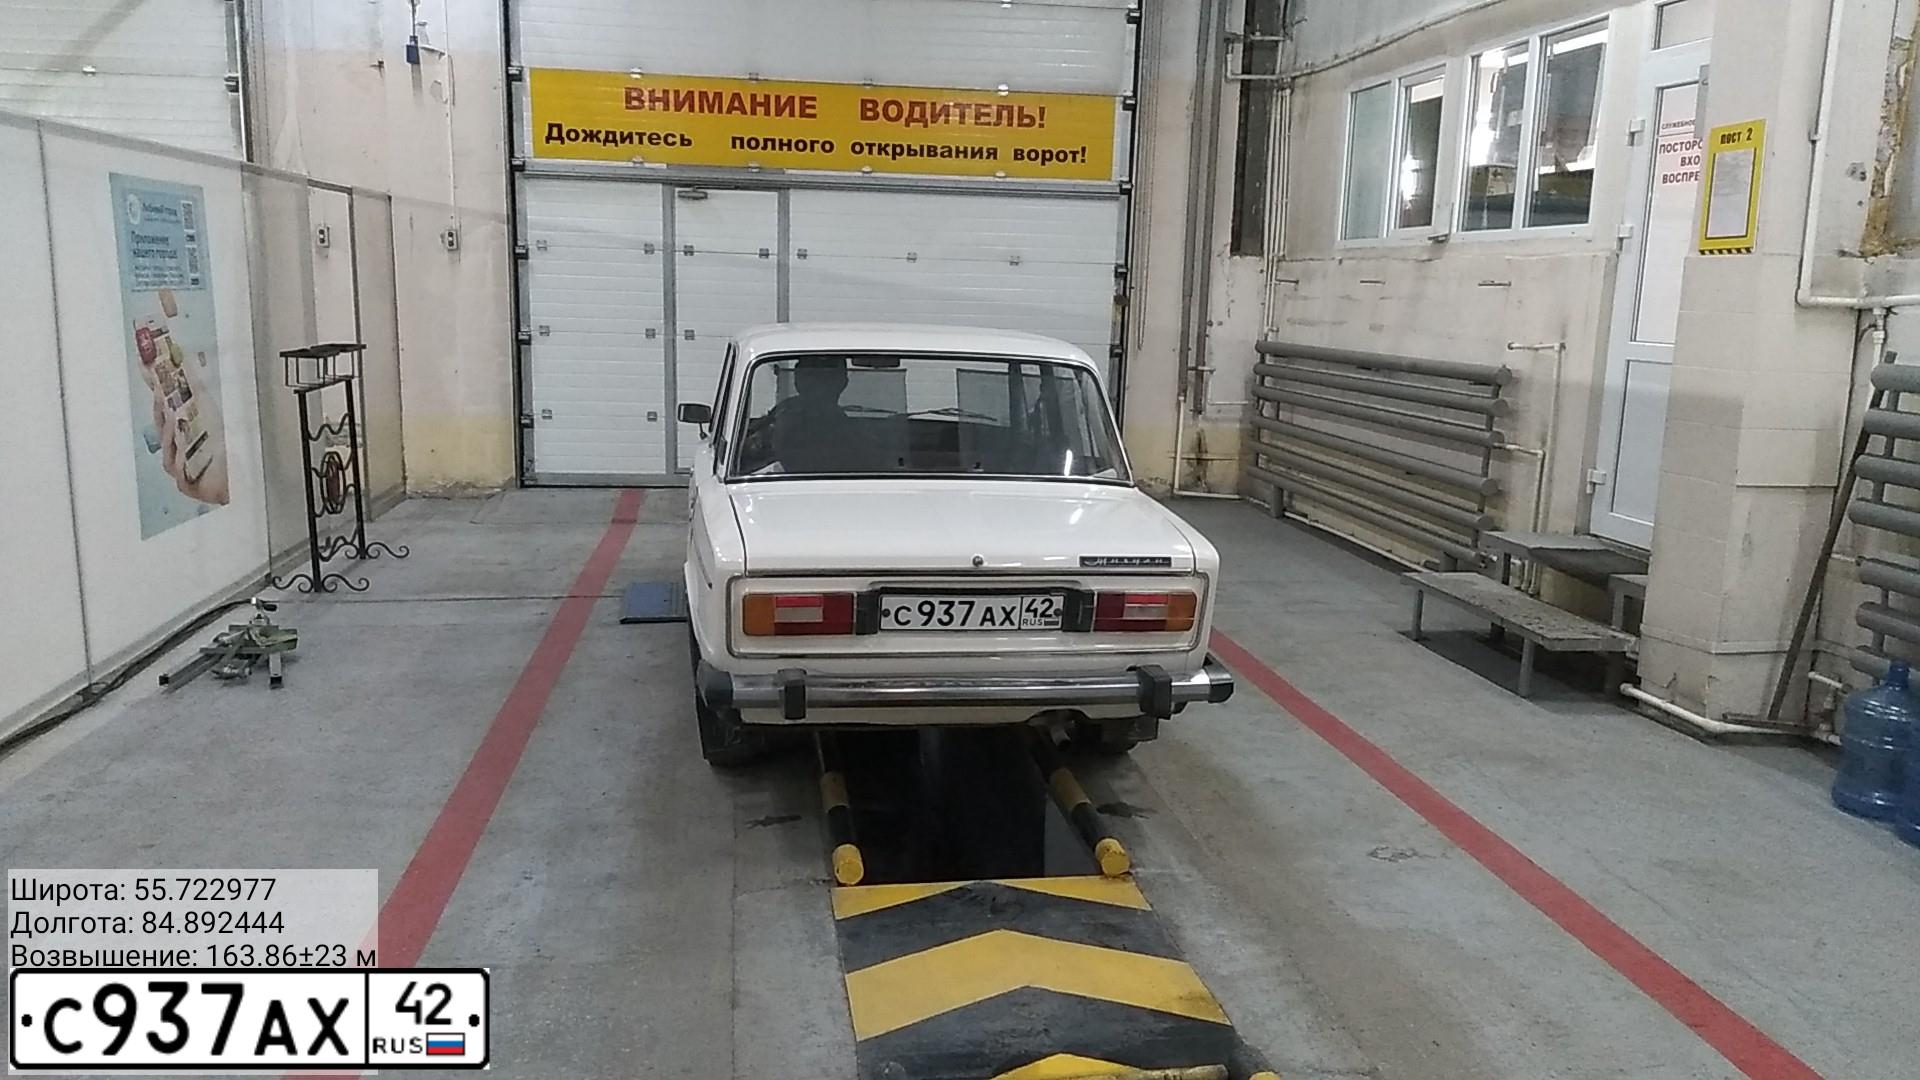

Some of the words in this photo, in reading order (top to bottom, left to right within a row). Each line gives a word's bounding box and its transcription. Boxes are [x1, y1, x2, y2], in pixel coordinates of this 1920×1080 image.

[624, 87, 818, 119] ВНИМАНИЕ
[860, 98, 1046, 129] ВОДИТЕЛЬ!
[1746, 127, 1753, 141] 2
[545, 123, 693, 147] Дождитесь
[731, 135, 835, 154] полного
[851, 141, 998, 161] открывания
[1013, 146, 1087, 166] ворот!
[1025, 598, 1054, 618] 42
[1022, 618, 1043, 627] RUS
